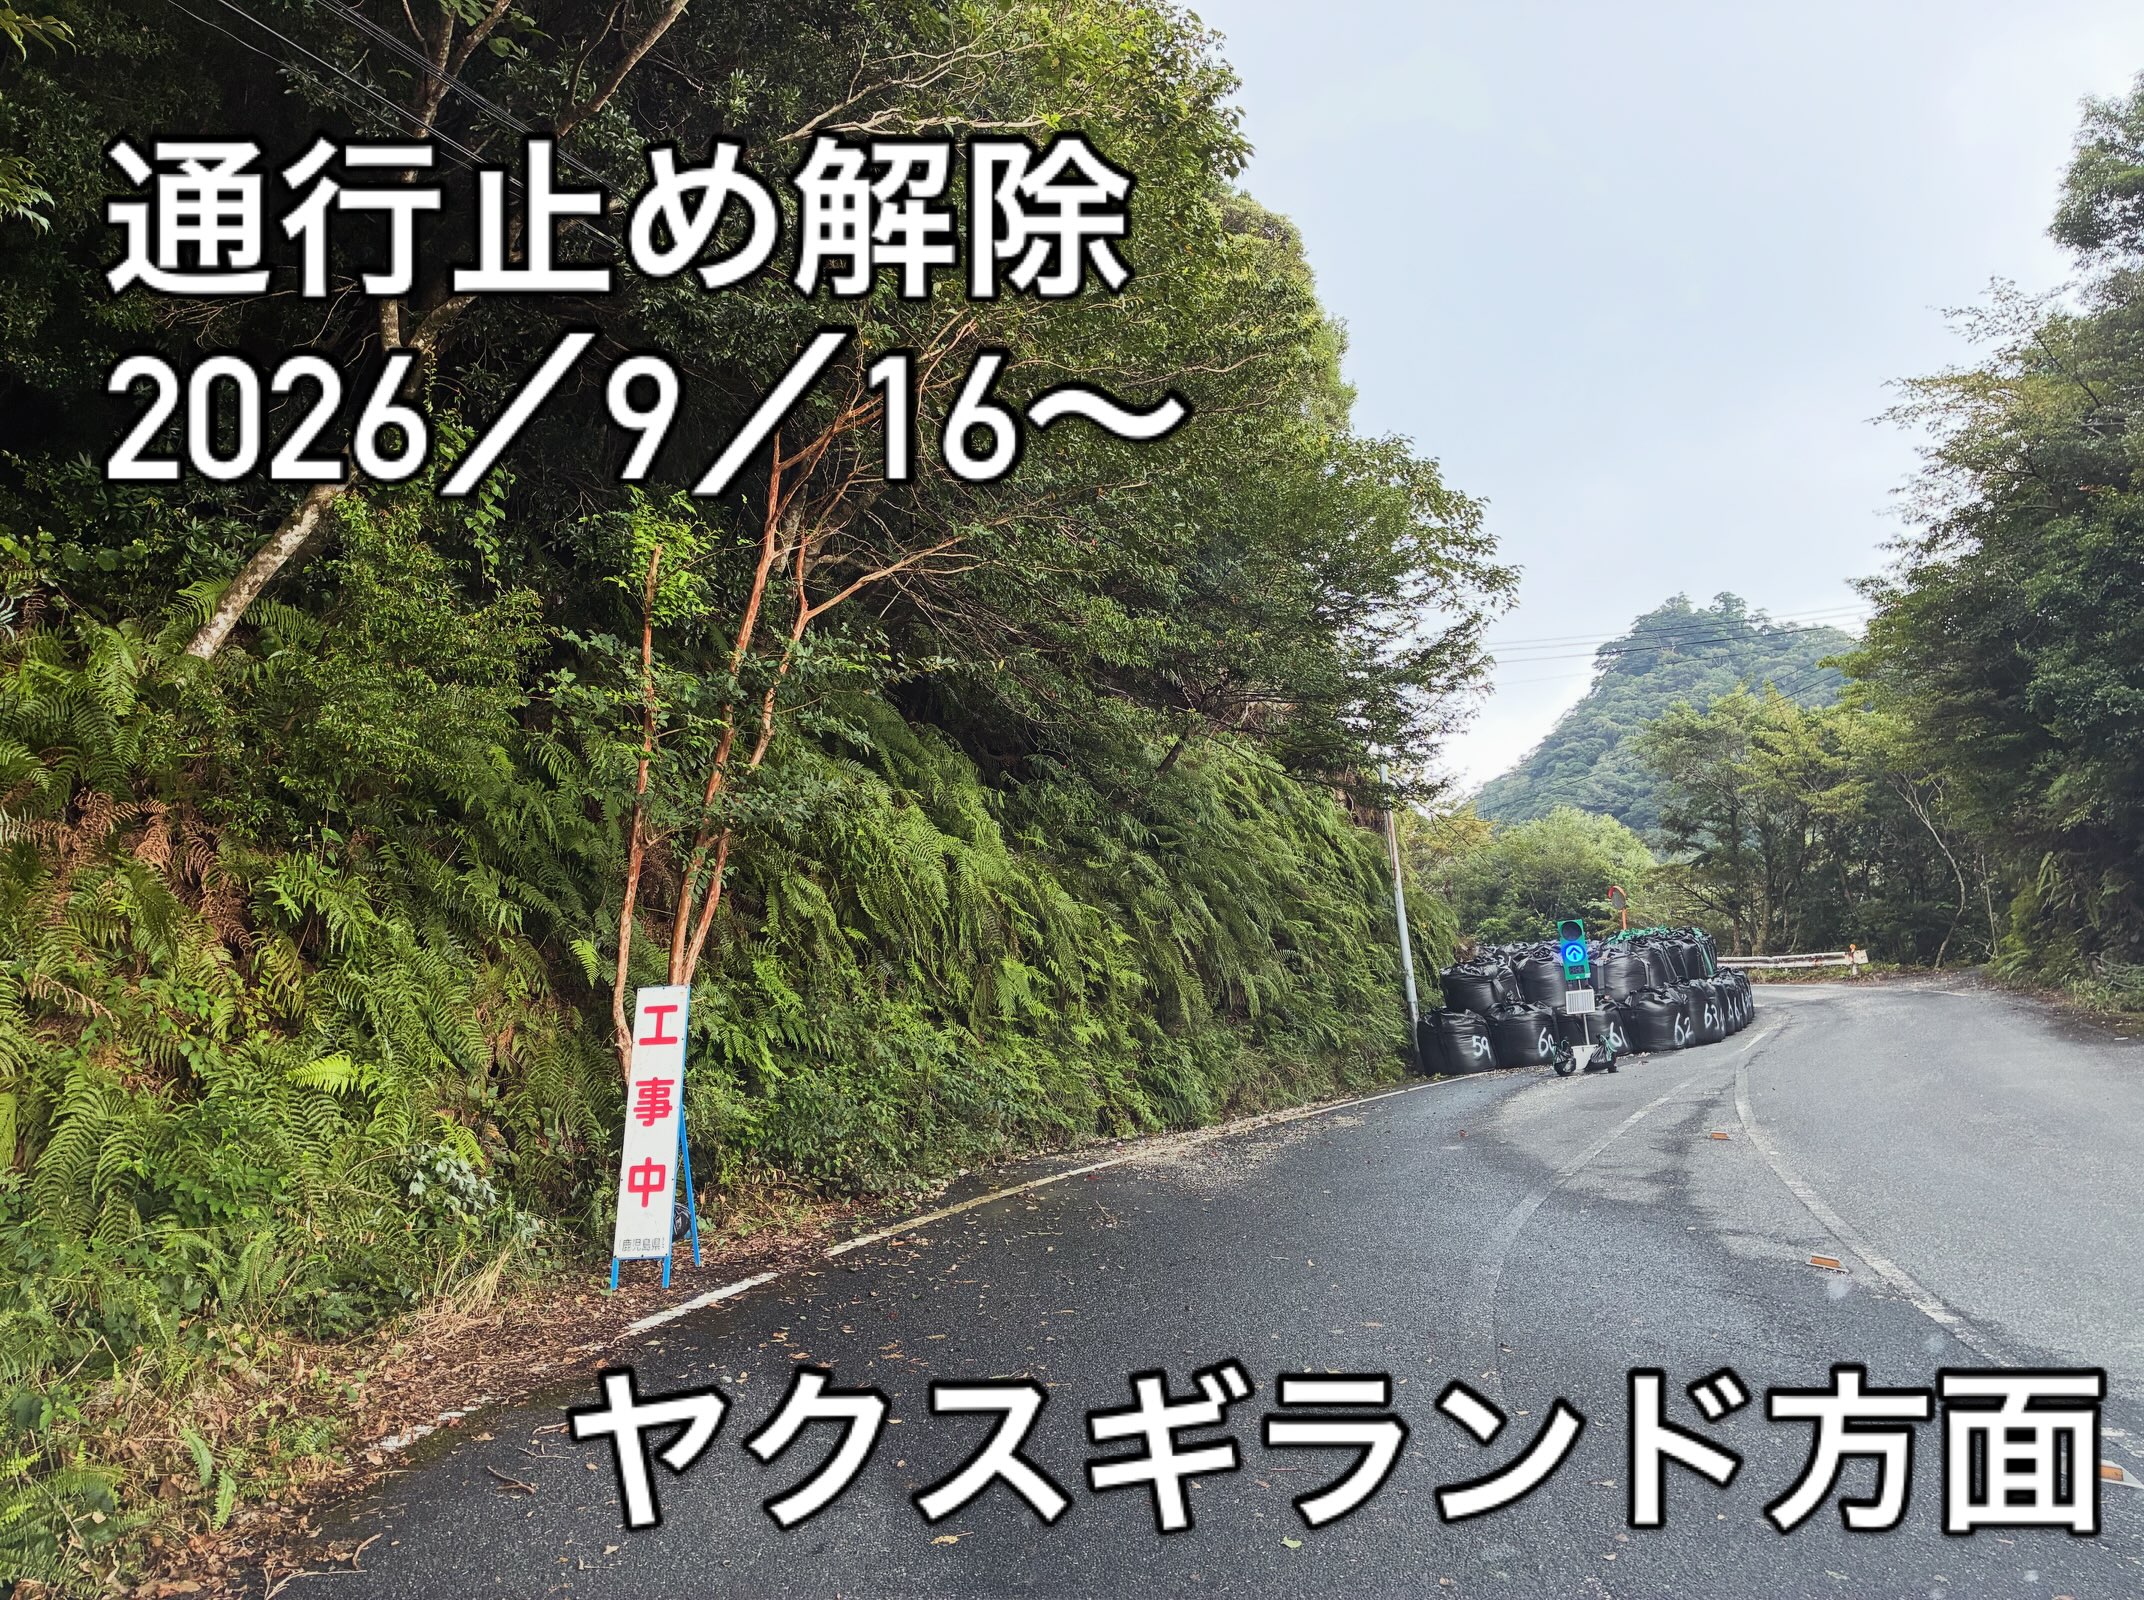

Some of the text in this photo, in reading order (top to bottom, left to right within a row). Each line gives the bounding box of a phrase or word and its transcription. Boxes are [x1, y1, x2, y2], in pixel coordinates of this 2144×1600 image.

[1674, 1012, 1694, 1046] 62
[1704, 1003, 1720, 1030] 63
[1472, 1035, 1492, 1063] 59
[1609, 1021, 1628, 1049] 61
[627, 1003, 679, 1208] 工事中
